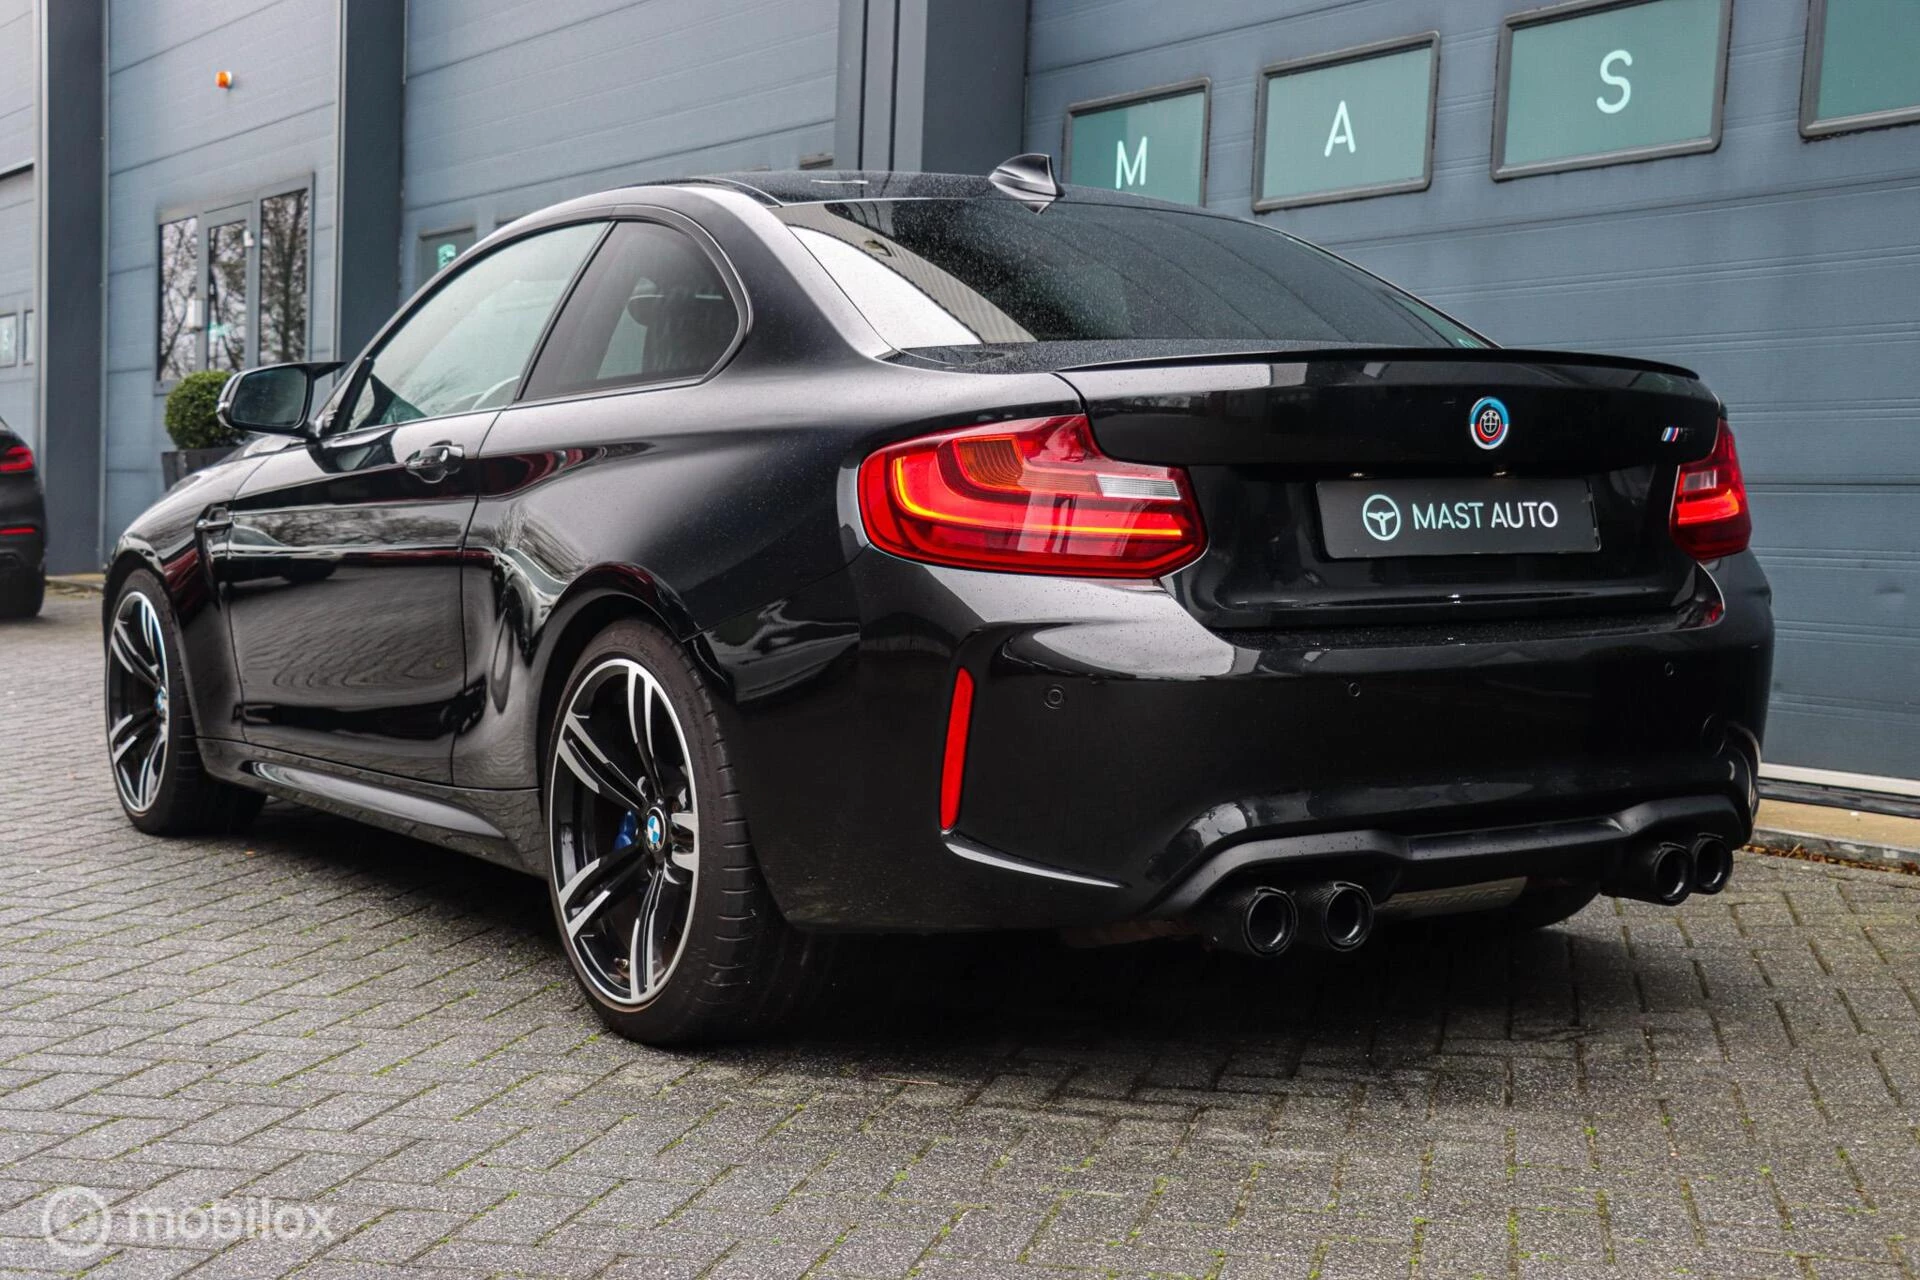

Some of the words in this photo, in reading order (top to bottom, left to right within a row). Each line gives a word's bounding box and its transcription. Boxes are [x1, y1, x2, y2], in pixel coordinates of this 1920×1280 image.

[1114, 136, 1148, 190] M
[1323, 100, 1357, 157] A
[1596, 49, 1634, 114] S
[1411, 501, 1484, 530] MAST
[1490, 501, 1560, 529] AUTO
